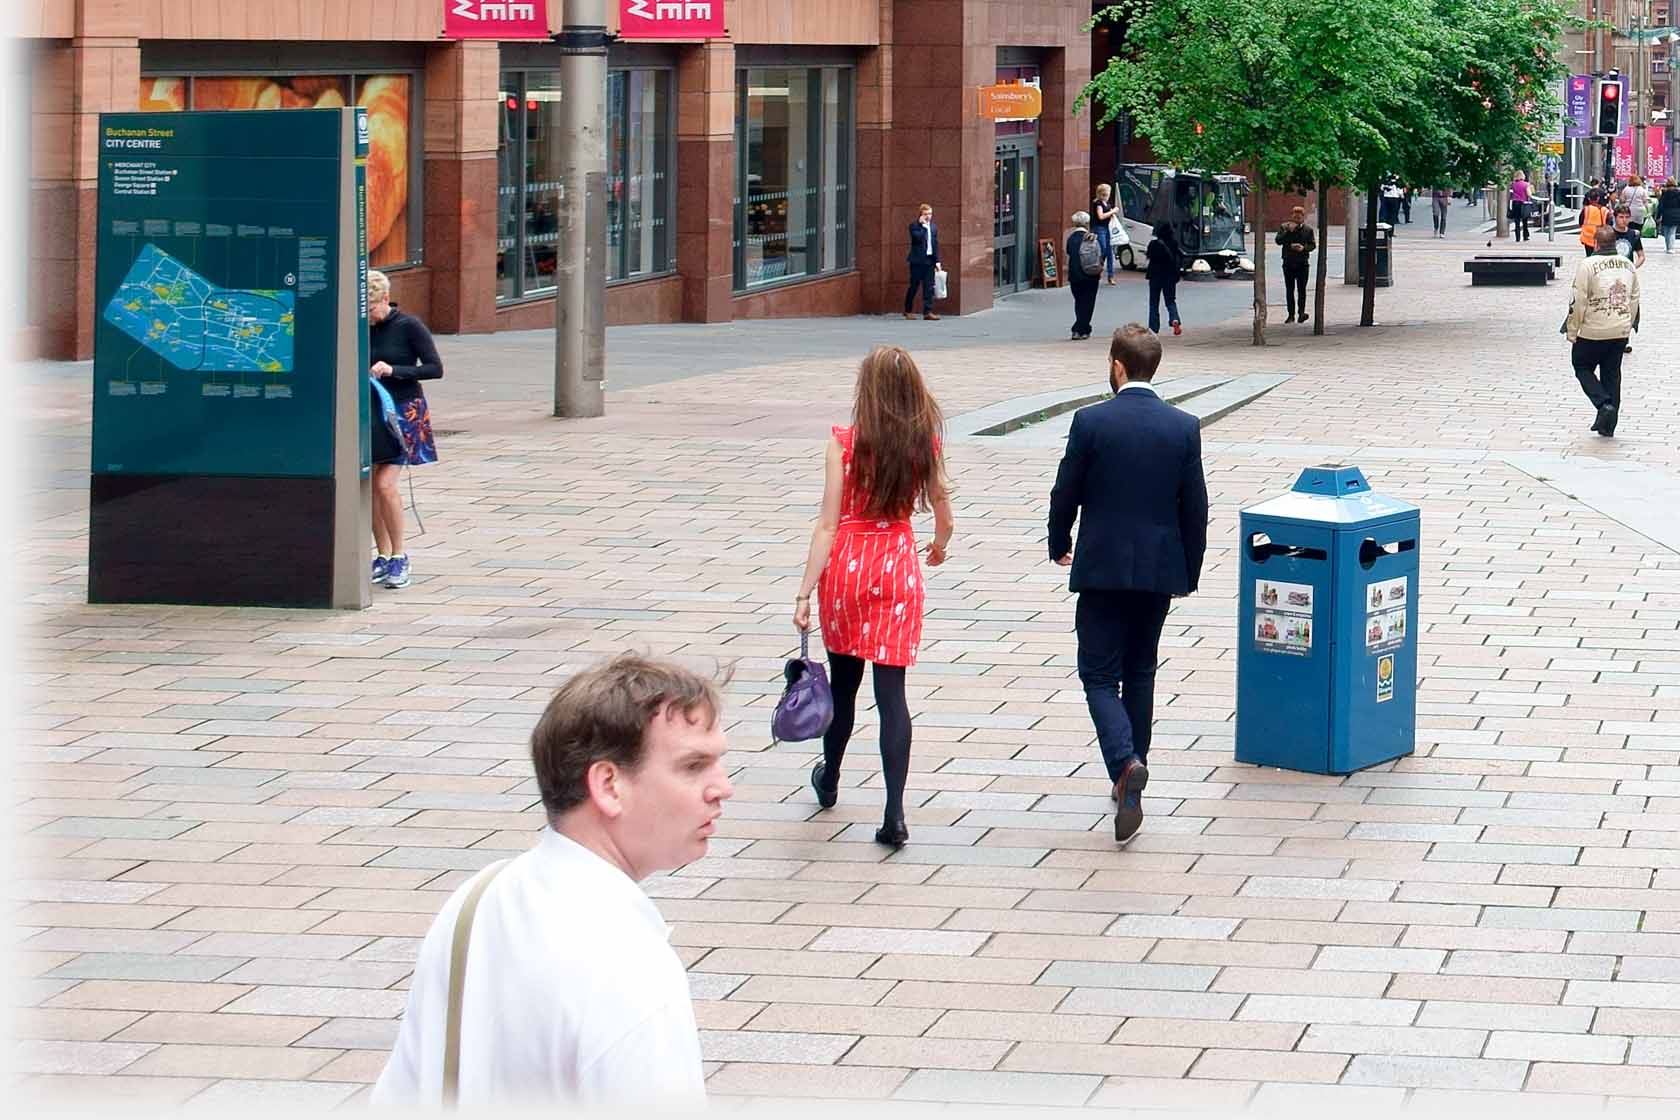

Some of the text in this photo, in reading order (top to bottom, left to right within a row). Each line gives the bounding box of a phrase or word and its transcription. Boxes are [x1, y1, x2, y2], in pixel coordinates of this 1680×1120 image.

[106, 128, 174, 137] Buchanan Street
[106, 139, 160, 148] CITY CENTRE
